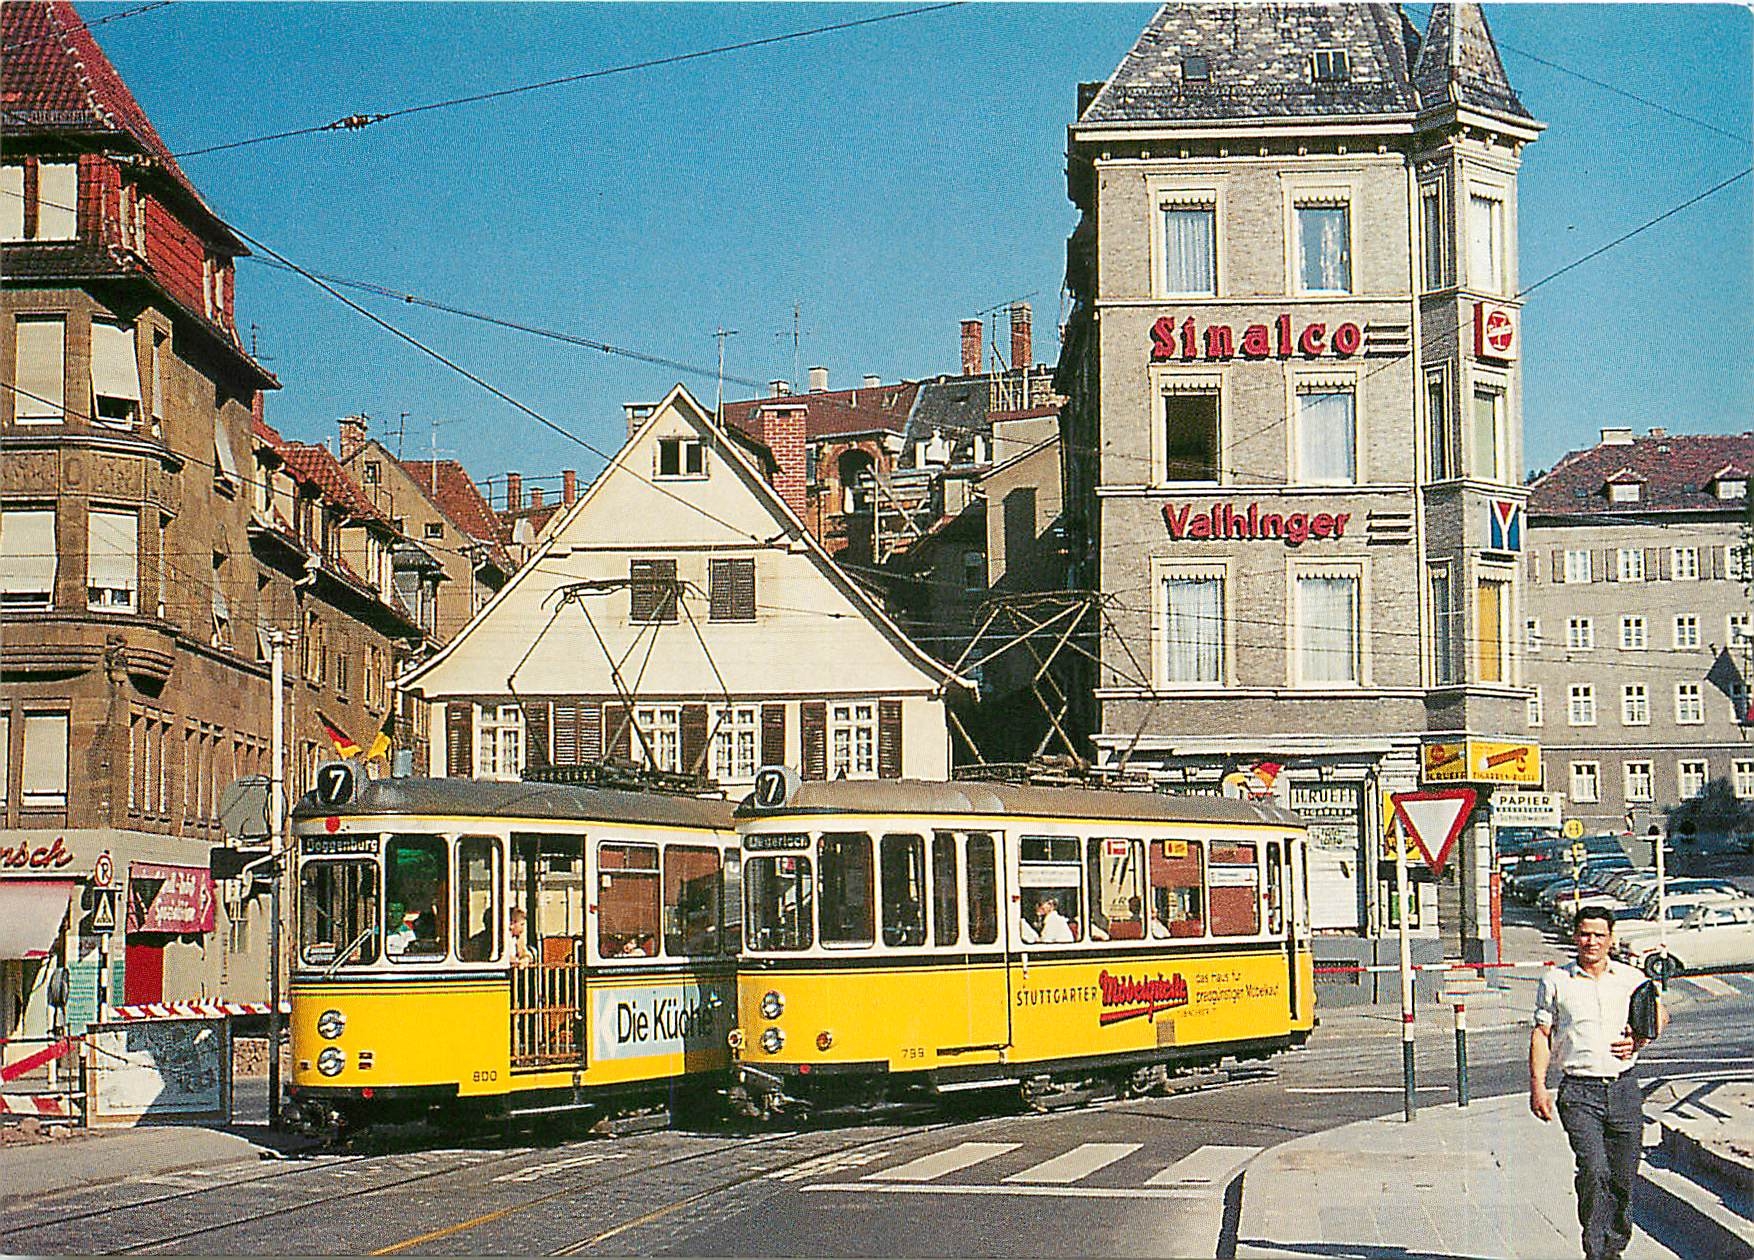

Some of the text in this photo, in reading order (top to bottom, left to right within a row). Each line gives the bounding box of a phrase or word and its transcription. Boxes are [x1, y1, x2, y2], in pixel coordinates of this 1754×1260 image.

[1151, 313, 1362, 359] Sinalco
[329, 769, 346, 801] 7
[765, 773, 780, 803] 7
[1500, 796, 1550, 805] PAPIER
[305, 838, 379, 853] Doggenburg
[1016, 986, 1098, 1007] STUTTGARTER
[616, 1000, 649, 1044] Die
[472, 1069, 498, 1083] 800
